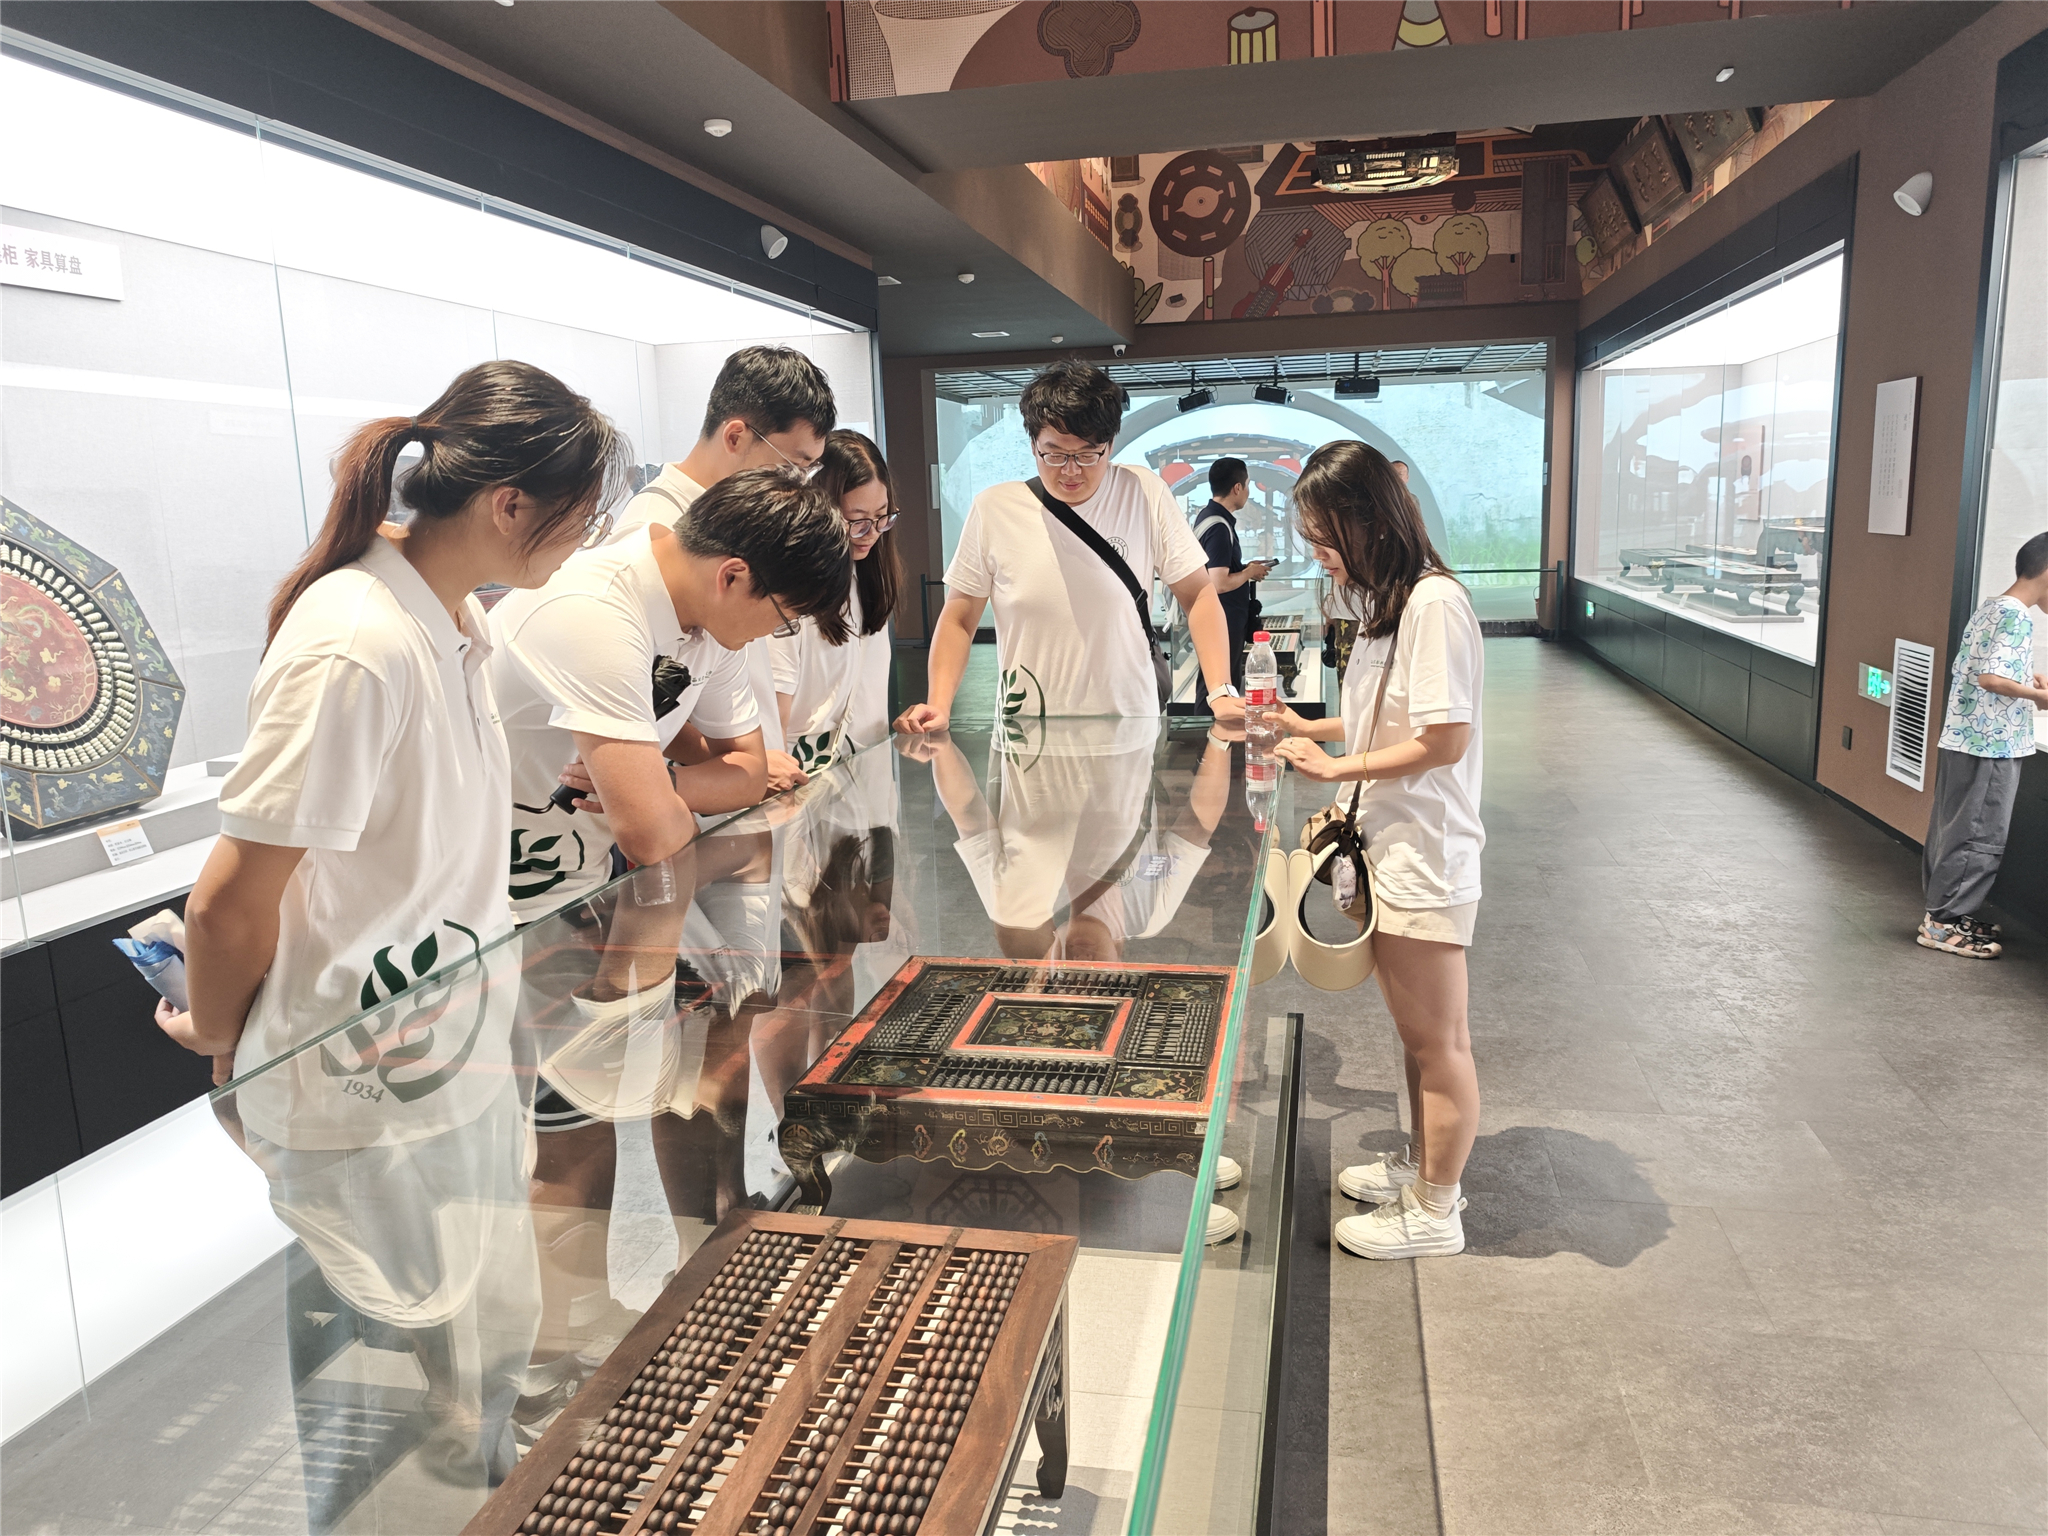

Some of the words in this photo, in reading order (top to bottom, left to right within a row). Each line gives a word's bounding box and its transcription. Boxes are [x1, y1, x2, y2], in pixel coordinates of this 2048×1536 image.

[24, 248, 82, 275] 家具算盘
[341, 1079, 385, 1103] 1934
